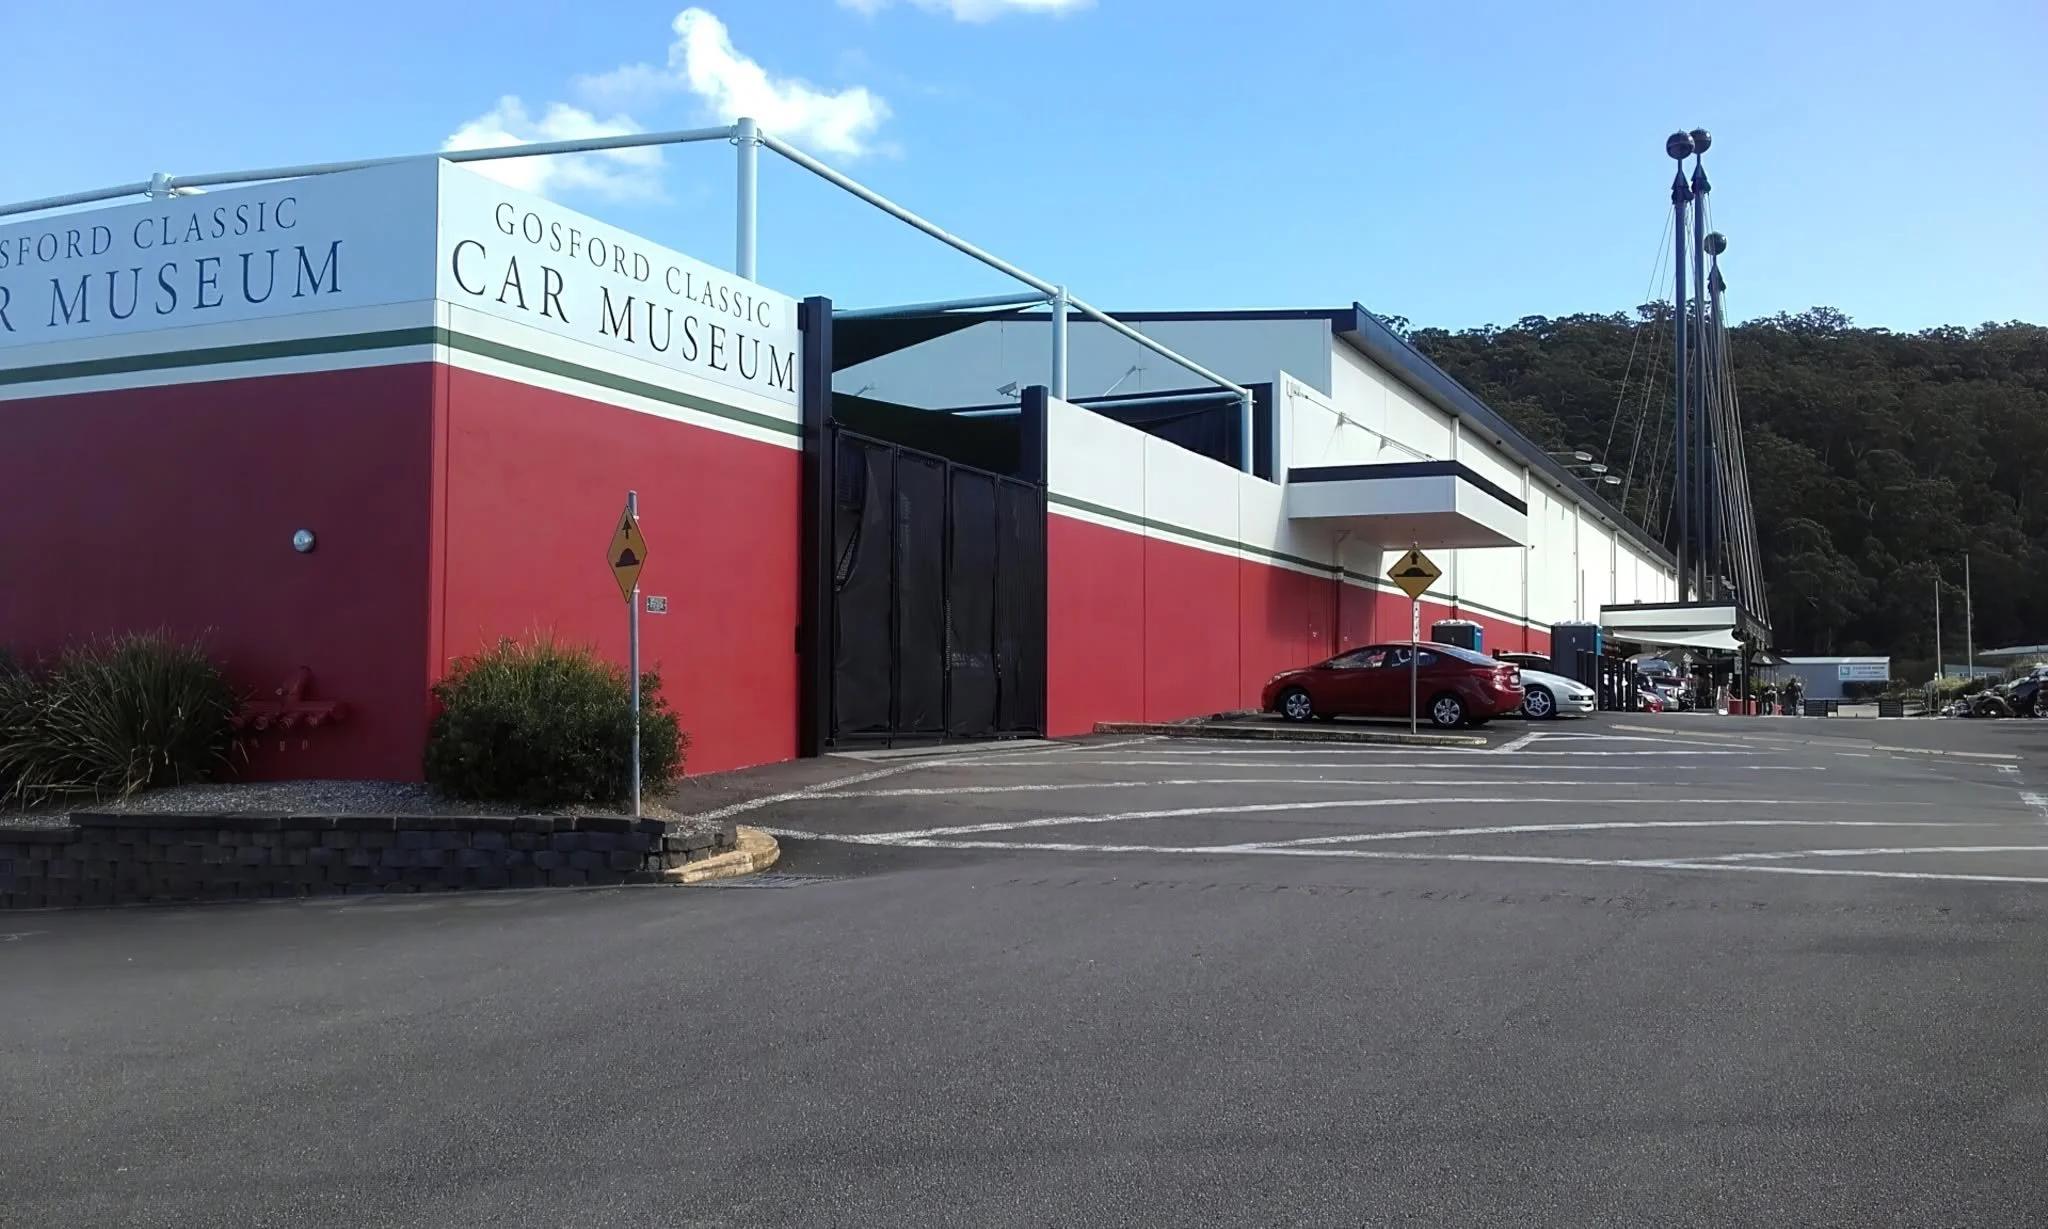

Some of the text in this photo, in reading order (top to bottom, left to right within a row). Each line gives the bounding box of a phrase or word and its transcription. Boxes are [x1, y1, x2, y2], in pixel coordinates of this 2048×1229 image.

[133, 197, 297, 250] CLASSIC
[495, 202, 771, 328] GOSFORD CLASSIC
[47, 240, 343, 327] MUSEUM
[452, 239, 796, 393] CAR MUSEUM
